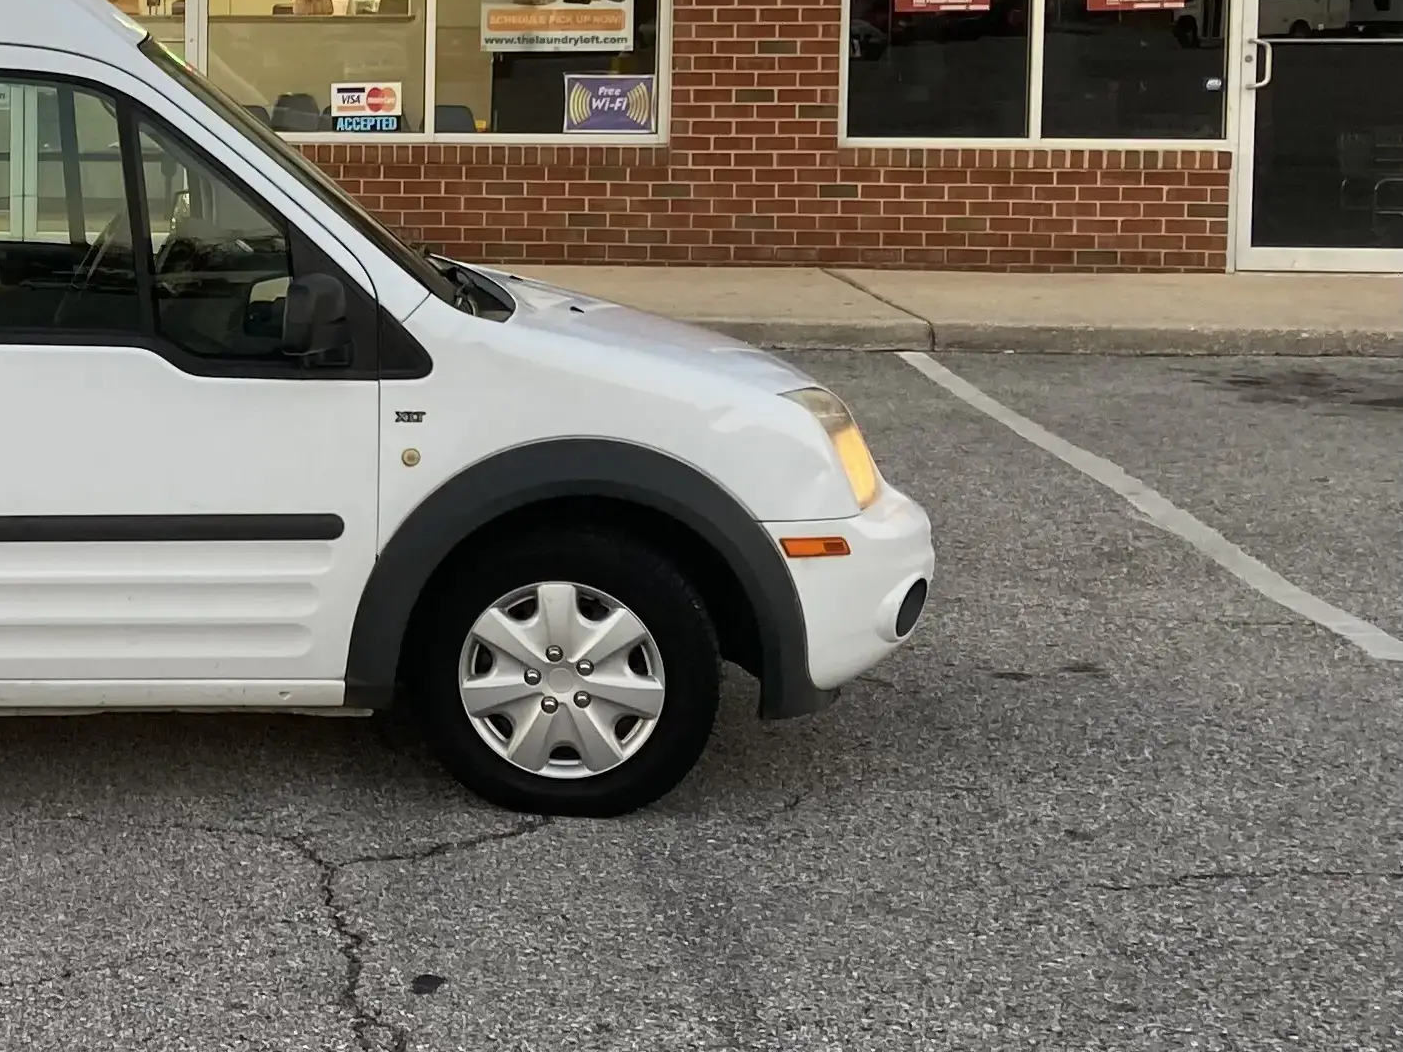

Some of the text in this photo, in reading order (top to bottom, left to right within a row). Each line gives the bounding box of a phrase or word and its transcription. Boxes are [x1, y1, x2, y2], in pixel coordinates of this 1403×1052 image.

[576, 12, 592, 23] UP
[484, 34, 628, 46] www.thelaundryloft.com
[598, 86, 622, 96] Free
[341, 94, 361, 105] VISA
[591, 97, 628, 112] Wi-Fi
[336, 116, 398, 131] ACCEPTED
[394, 411, 427, 423] XLT
